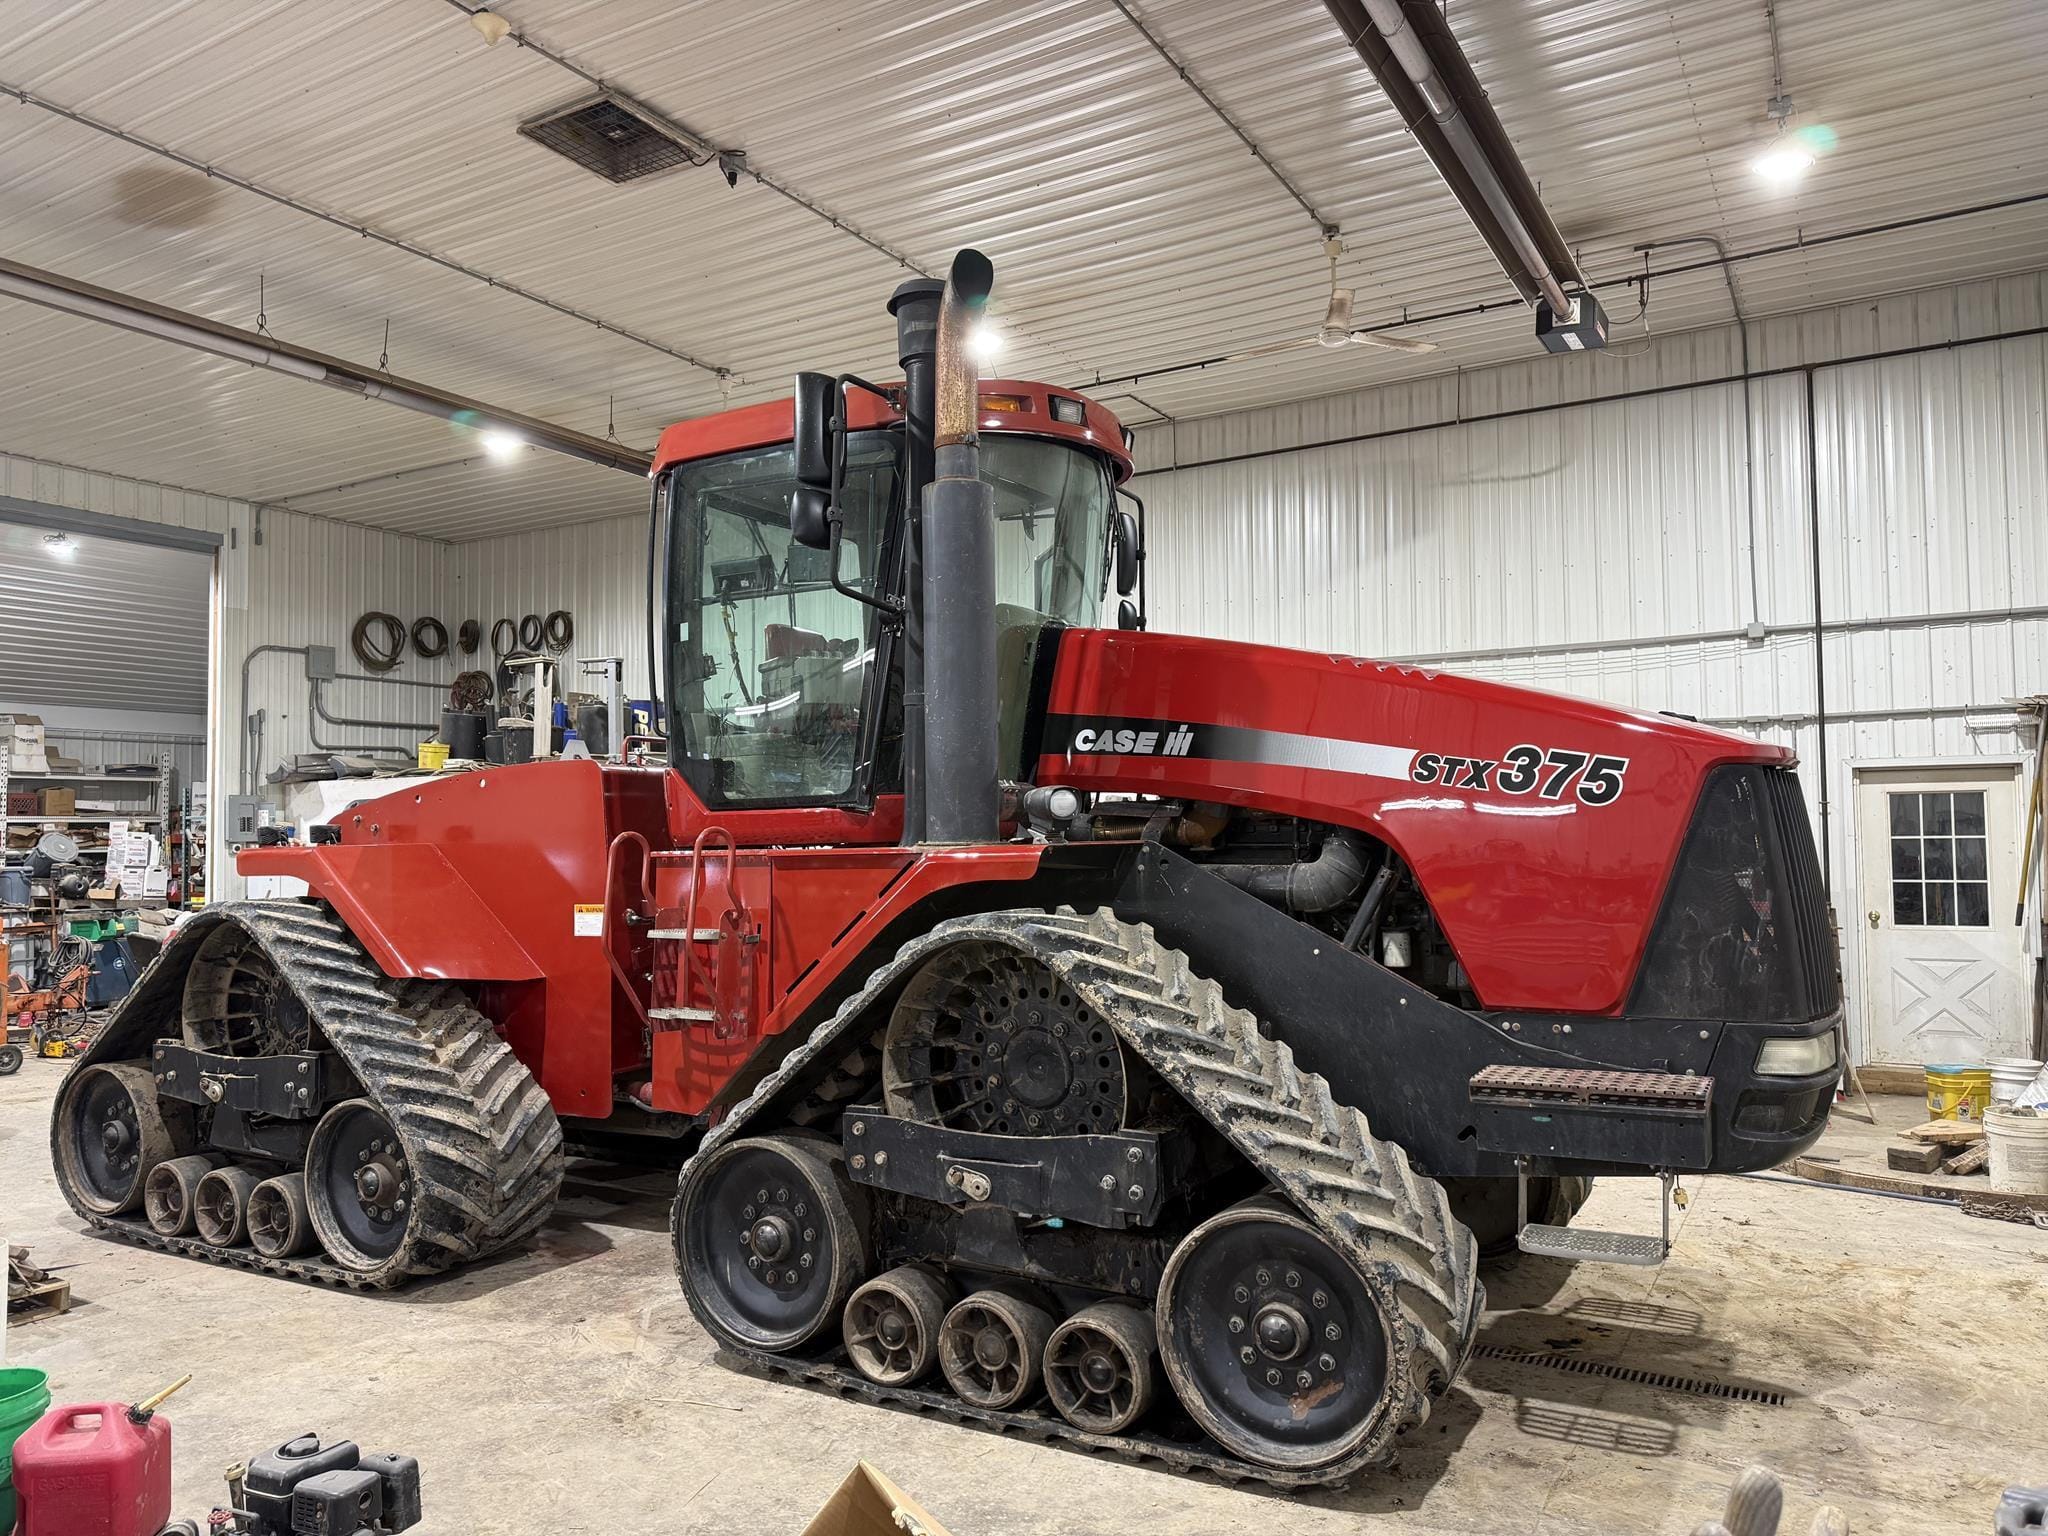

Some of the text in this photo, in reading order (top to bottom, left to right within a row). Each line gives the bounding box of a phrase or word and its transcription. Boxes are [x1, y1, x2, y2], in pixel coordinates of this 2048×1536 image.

[1075, 728, 1160, 754] CASE
[1412, 743, 1630, 807] STX 375
[38, 1475, 106, 1491] GASOLINE
